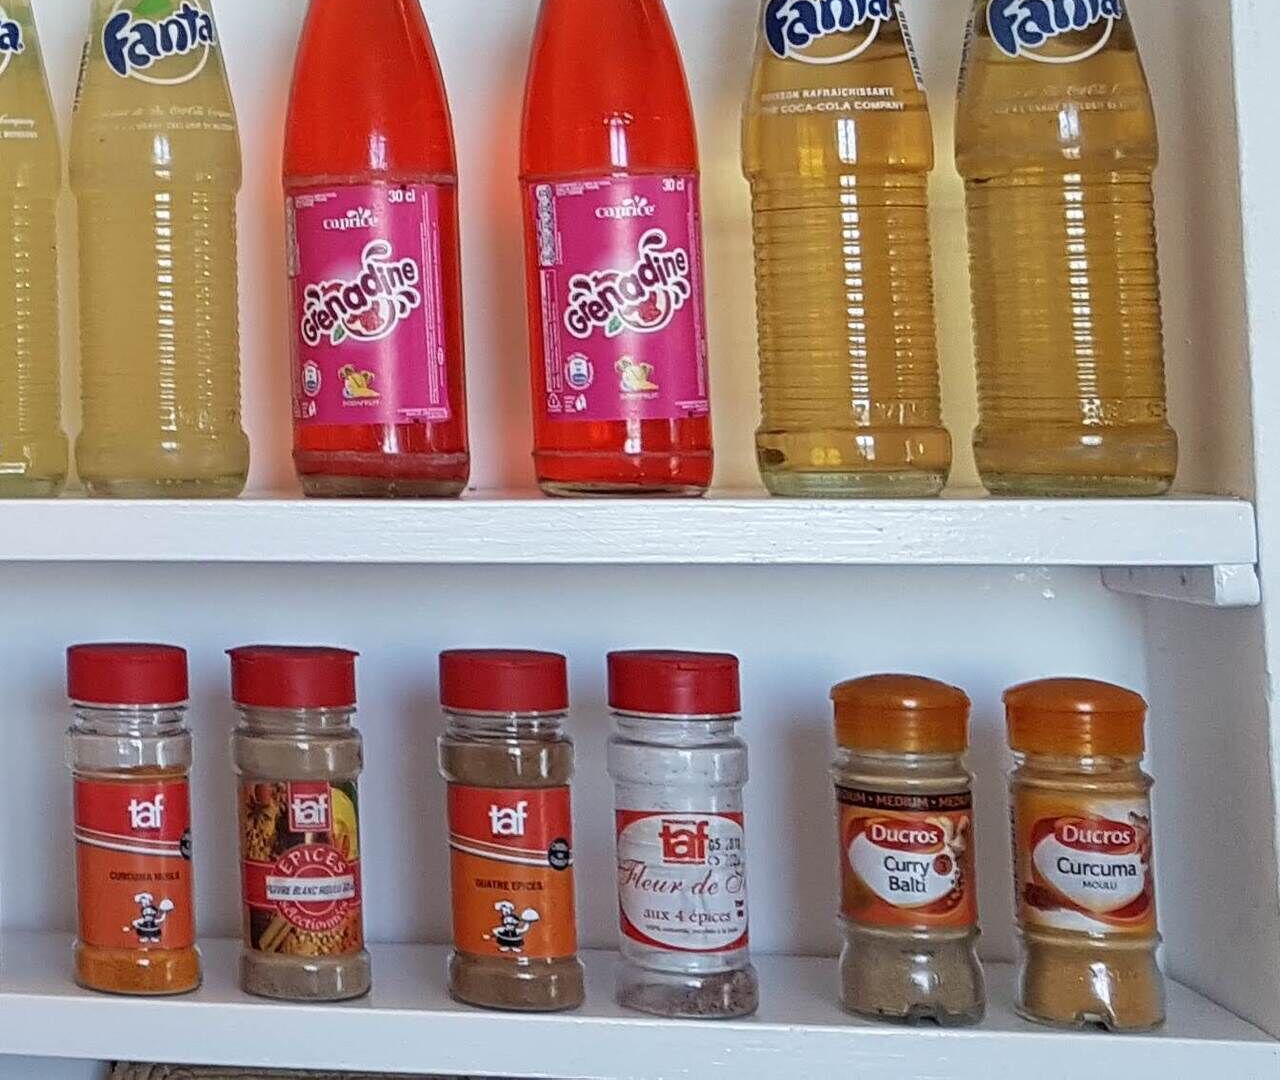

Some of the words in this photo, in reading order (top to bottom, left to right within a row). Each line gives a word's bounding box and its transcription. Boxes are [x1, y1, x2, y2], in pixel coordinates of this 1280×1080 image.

[103, 1, 215, 76] Fanta
[780, 101, 851, 114] COCA-COLA
[854, 100, 906, 111] COMPANY
[663, 179, 676, 192] 30
[677, 178, 685, 192] cl
[388, 189, 403, 203] 30
[405, 189, 416, 203] cl
[595, 201, 655, 218] caprice
[323, 213, 378, 231] caprice
[300, 258, 418, 347] Grenadine
[564, 248, 689, 339] Grenadine
[128, 794, 164, 829] taf
[292, 793, 328, 824] taf
[876, 795, 929, 808] MEDIUM
[488, 800, 528, 836] taf
[658, 819, 709, 860] taf
[871, 825, 938, 844] Ducros
[1063, 825, 1131, 845] Ducros
[279, 848, 346, 875] EPICES
[884, 855, 930, 877] Curry
[1057, 856, 1137, 877] Curcuma
[617, 859, 683, 894] Fleur
[691, 869, 718, 895] de
[889, 875, 927, 893] Balti
[1083, 880, 1117, 890] MOULU
[643, 908, 670, 920] aux
[675, 910, 684, 921] 4
[689, 910, 731, 926] épices
